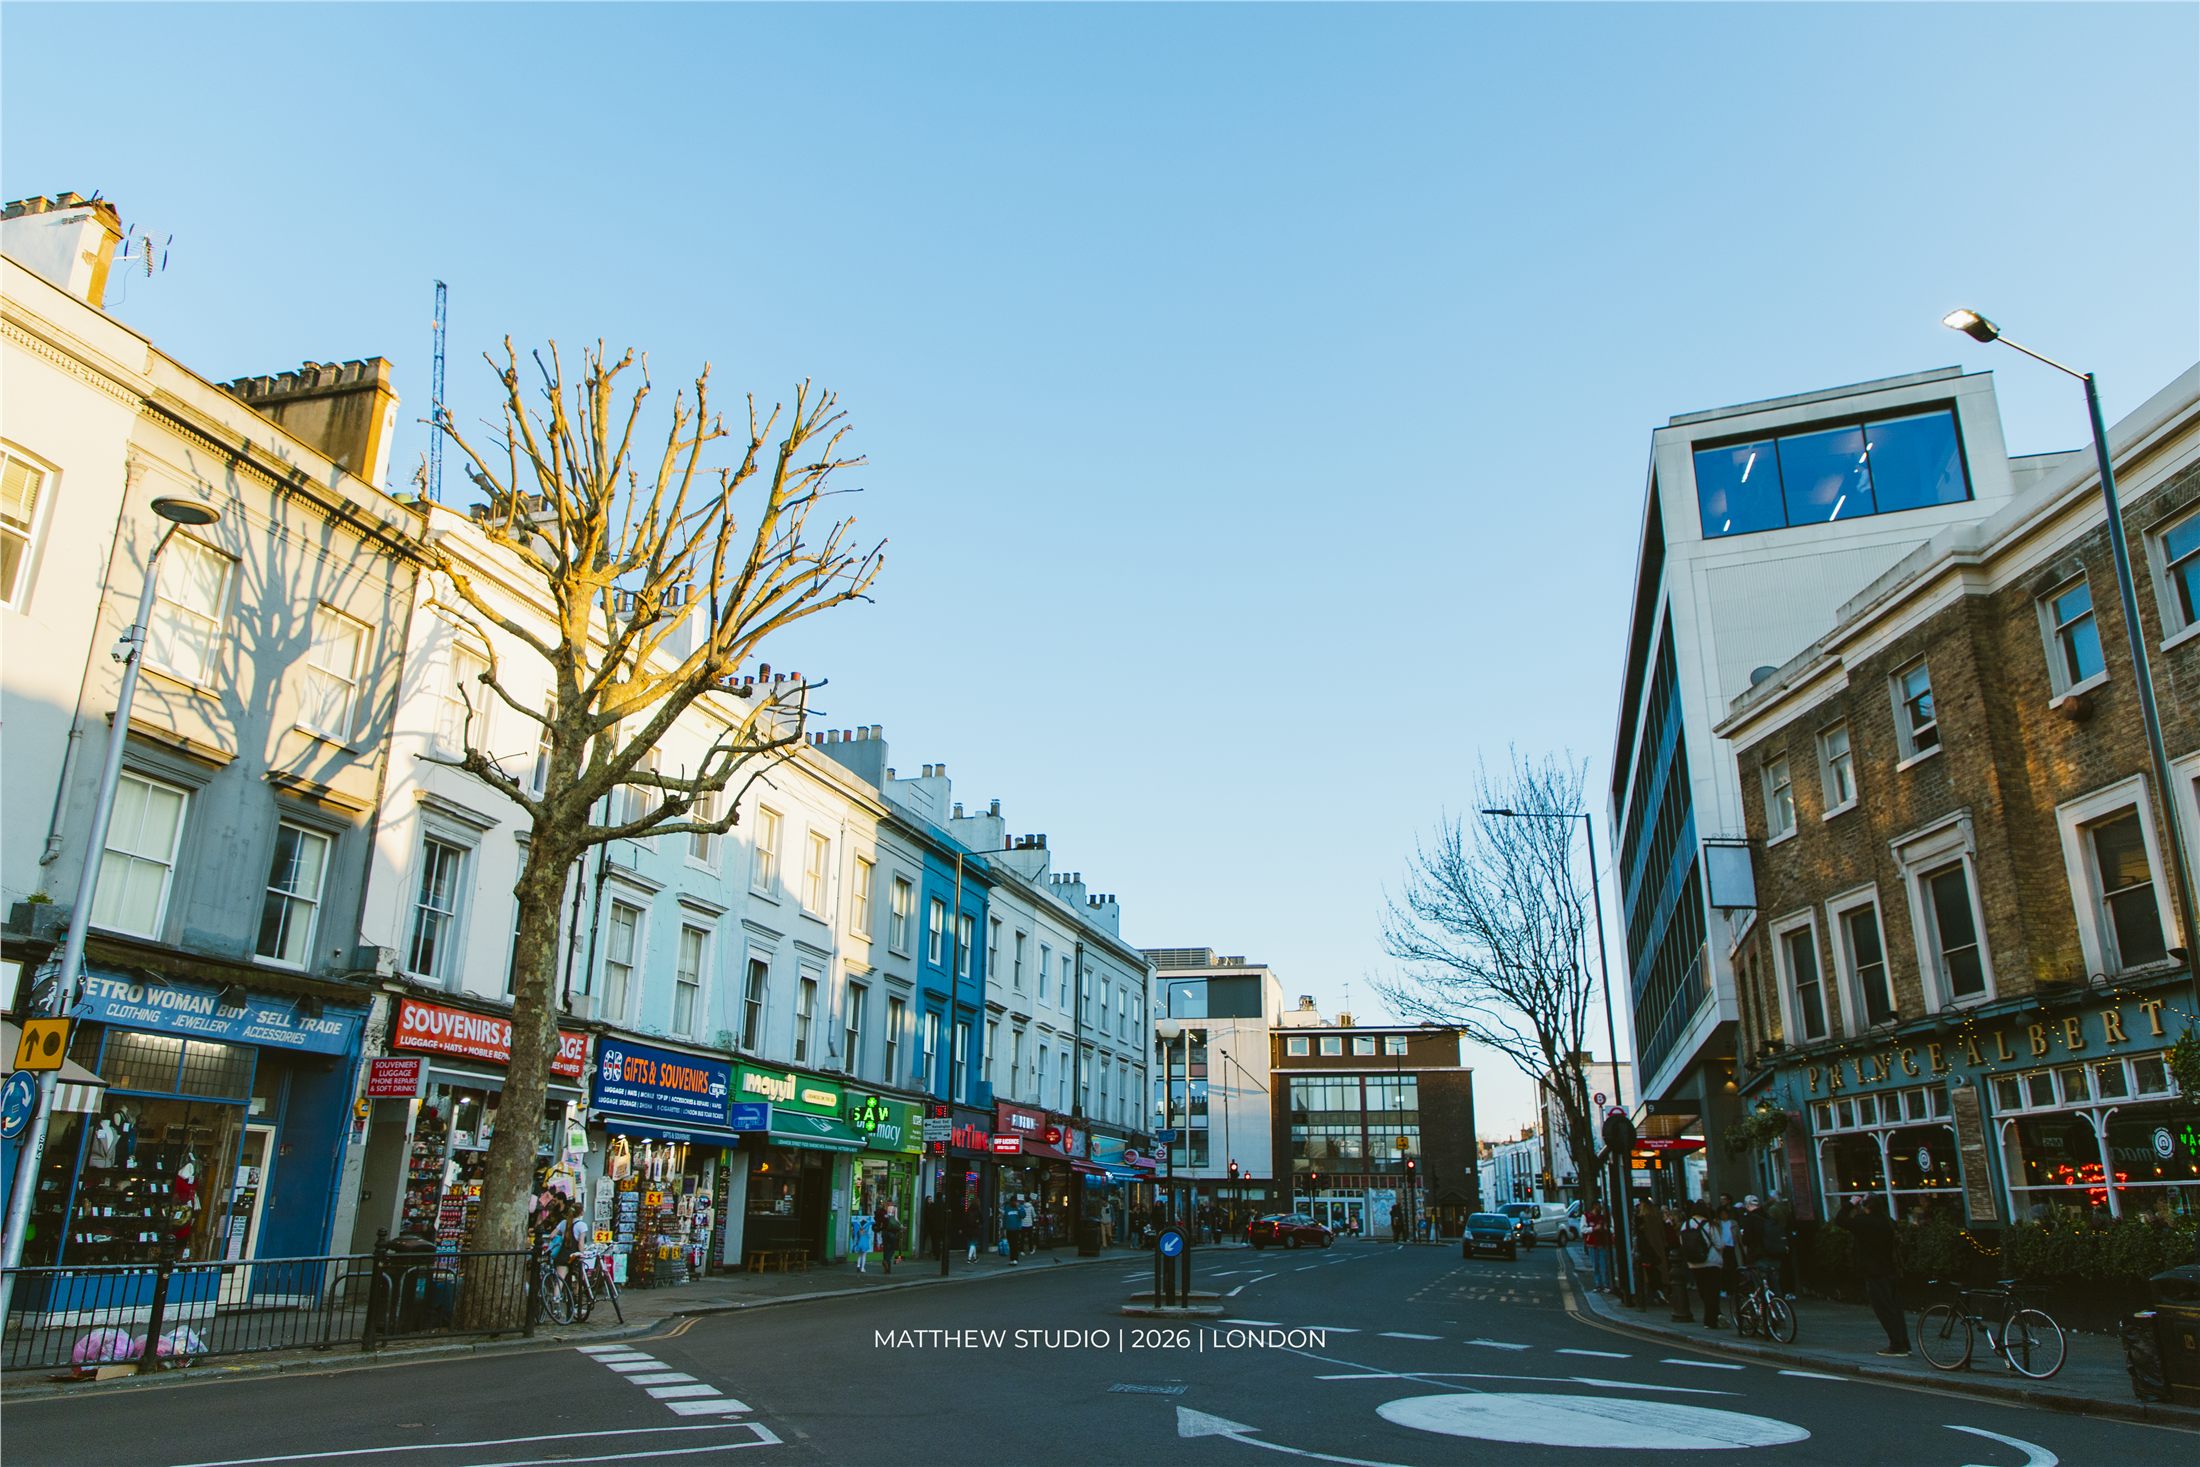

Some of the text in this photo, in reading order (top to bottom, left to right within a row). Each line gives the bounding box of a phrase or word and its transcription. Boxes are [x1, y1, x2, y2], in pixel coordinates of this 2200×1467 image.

[86, 976, 343, 1035] ETRO WOMAN BUY SELL TRADE
[106, 1003, 307, 1044] CLOTHING JEWELLERY ACCESSORIES
[400, 1035, 438, 1049] LUGGAGE
[443, 1042, 463, 1053] HATS
[468, 1046, 493, 1058] MOBILE
[403, 1005, 500, 1044] SOUVENIRS
[557, 1036, 584, 1060] AGE
[1808, 999, 2165, 1093] PRINCE ALBERT
[379, 1069, 412, 1077] LUGGAGE
[623, 1056, 709, 1094] GIFTS & SOUVENIRS
[648, 1193, 662, 1203] £1
[595, 1232, 610, 1242] £1
